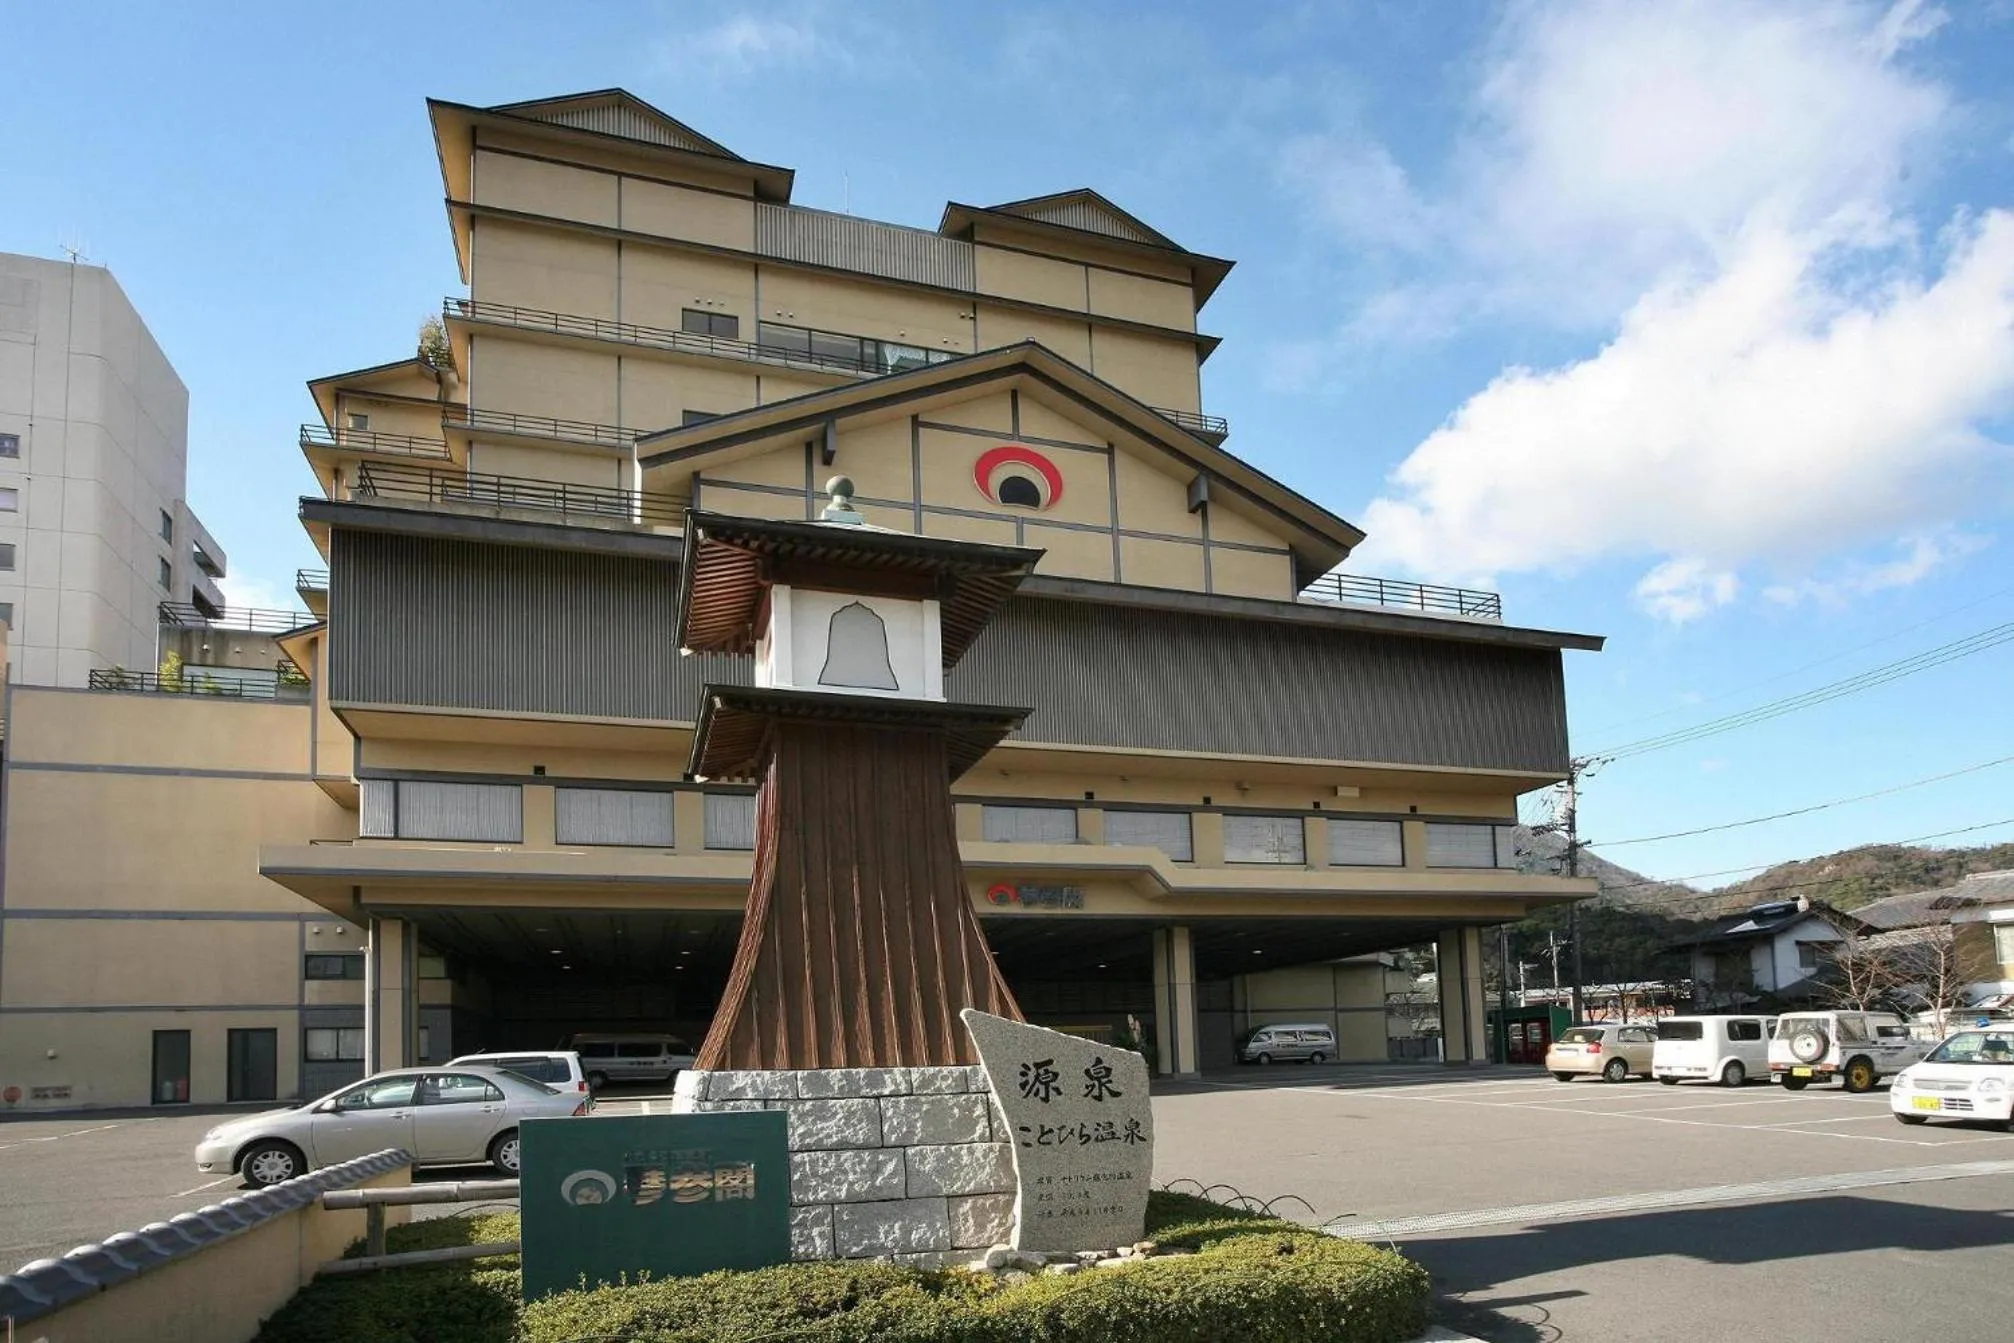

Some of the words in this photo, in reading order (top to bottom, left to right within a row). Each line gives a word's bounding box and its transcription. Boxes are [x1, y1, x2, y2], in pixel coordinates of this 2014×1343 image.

[1018, 1056, 1123, 1104] 源泉
[1018, 1118, 1147, 1148] ことひら温泉
